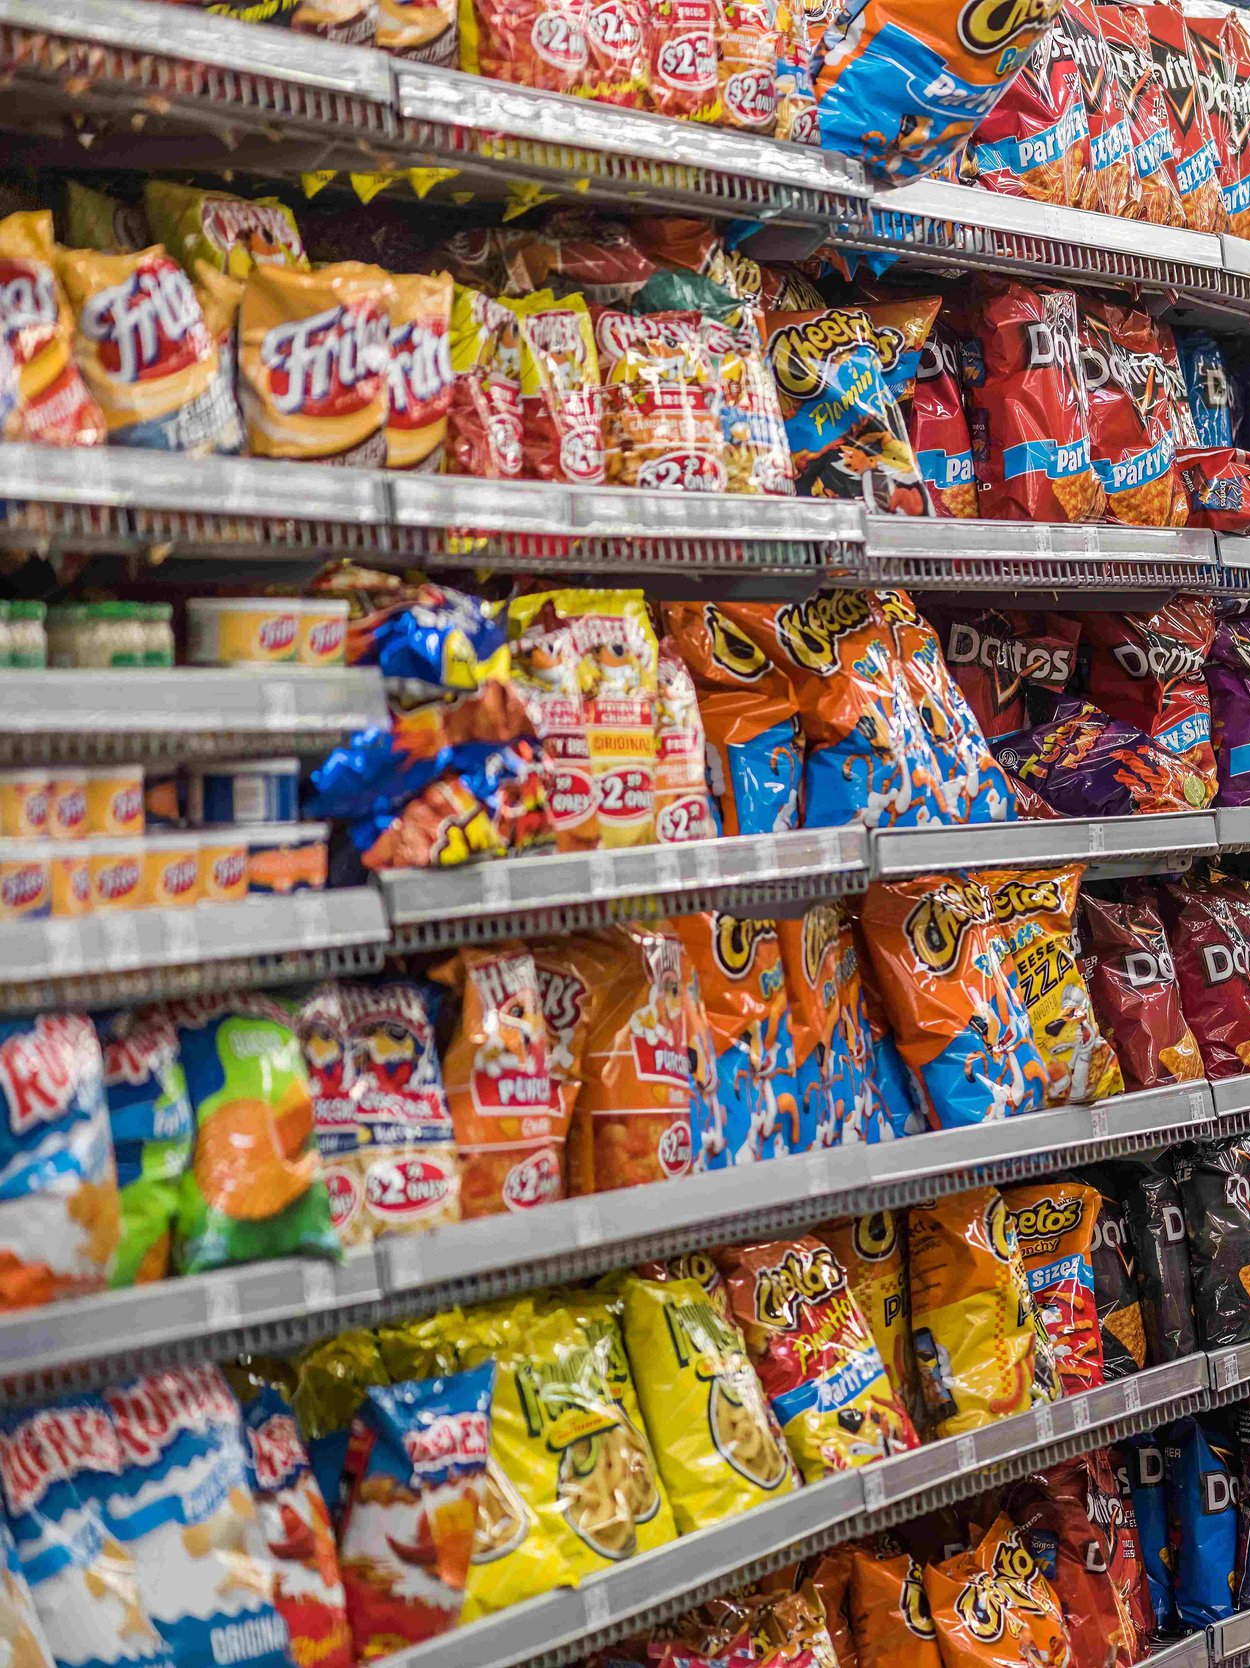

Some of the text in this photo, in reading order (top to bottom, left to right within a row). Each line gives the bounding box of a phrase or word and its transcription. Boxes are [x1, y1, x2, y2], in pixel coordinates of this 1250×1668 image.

[768, 309, 904, 398] Cheetos
[948, 623, 1070, 682] Doritos
[1017, 940, 1055, 975] EESE
[1019, 951, 1074, 1008] ZZA
